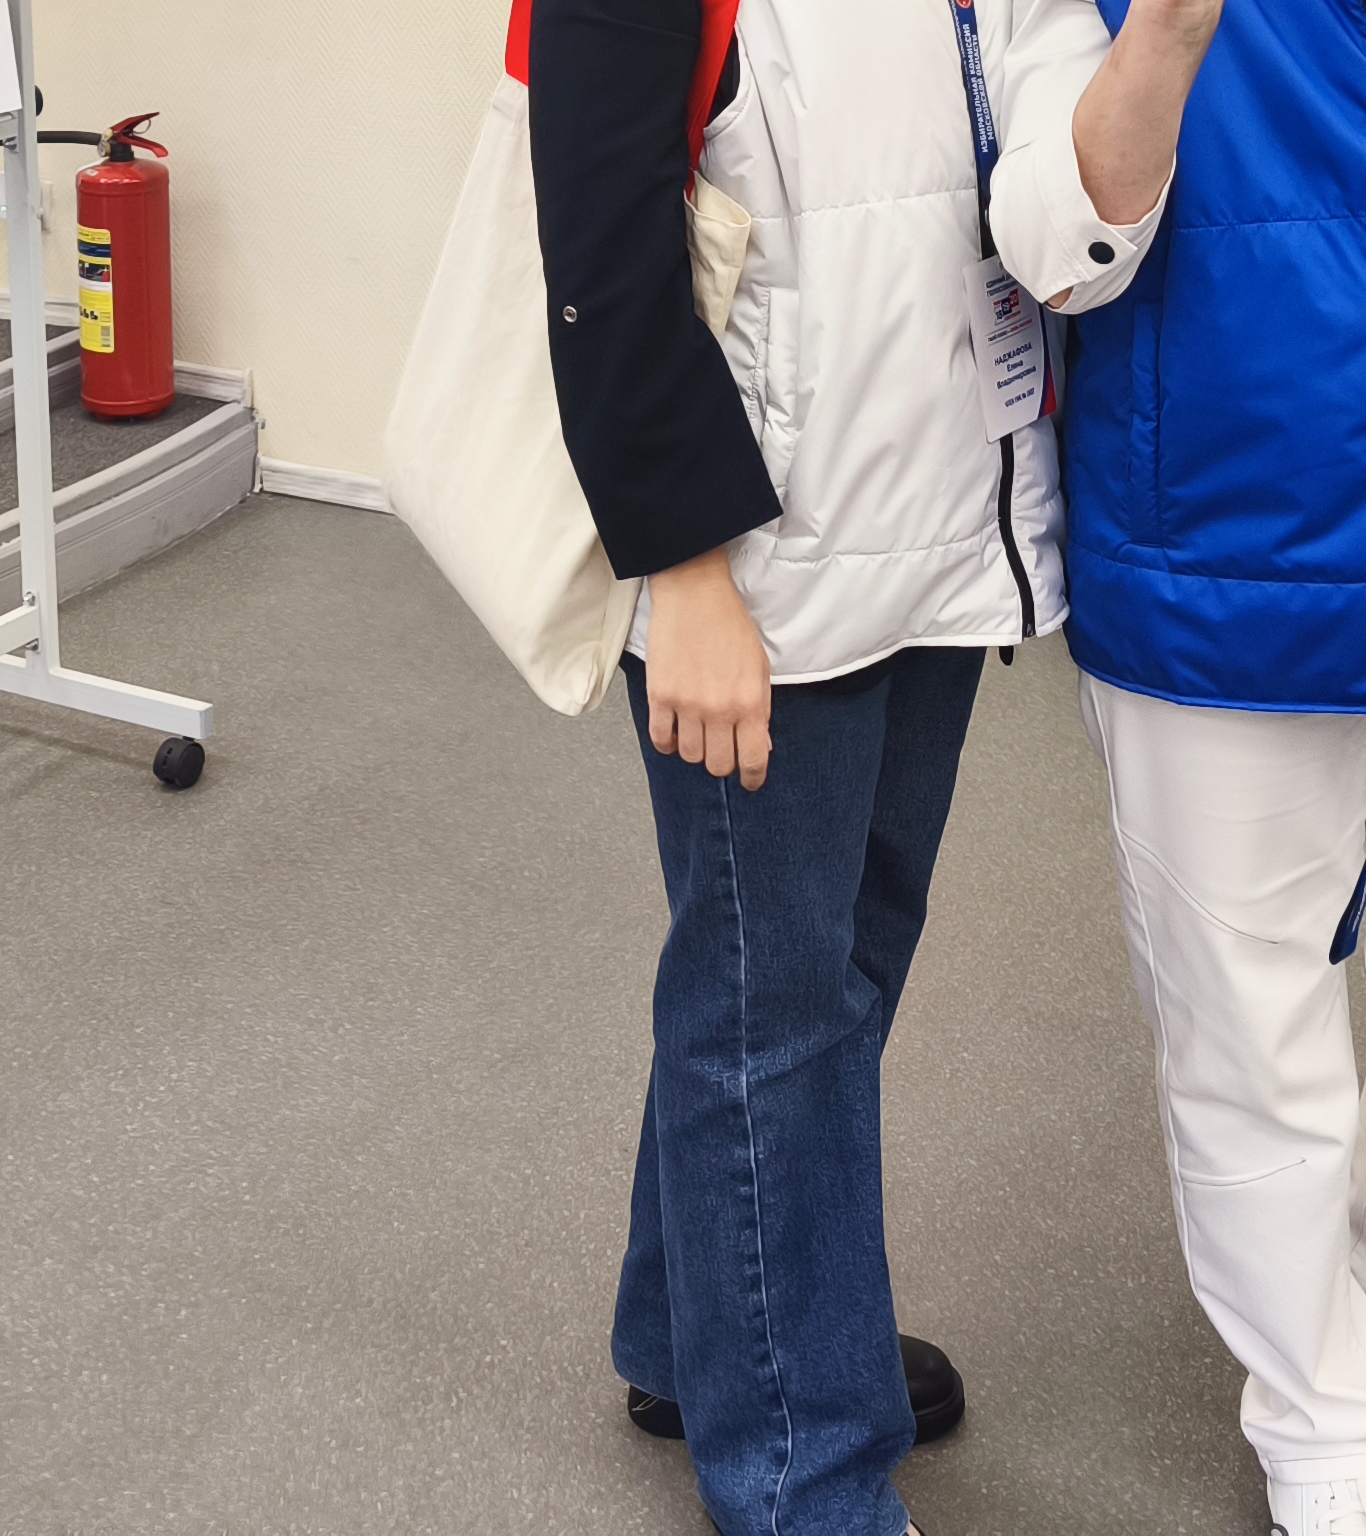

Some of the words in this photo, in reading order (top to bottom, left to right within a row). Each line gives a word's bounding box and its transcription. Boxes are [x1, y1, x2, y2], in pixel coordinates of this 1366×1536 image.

[962, 24, 976, 75] КОМИССИЯ
[971, 35, 982, 76] ОБЛАСТИ
[970, 77, 988, 152] ИЗБИРАТЕЛЬНАЯ
[977, 78, 994, 140] МОСКОВСКОЙ
